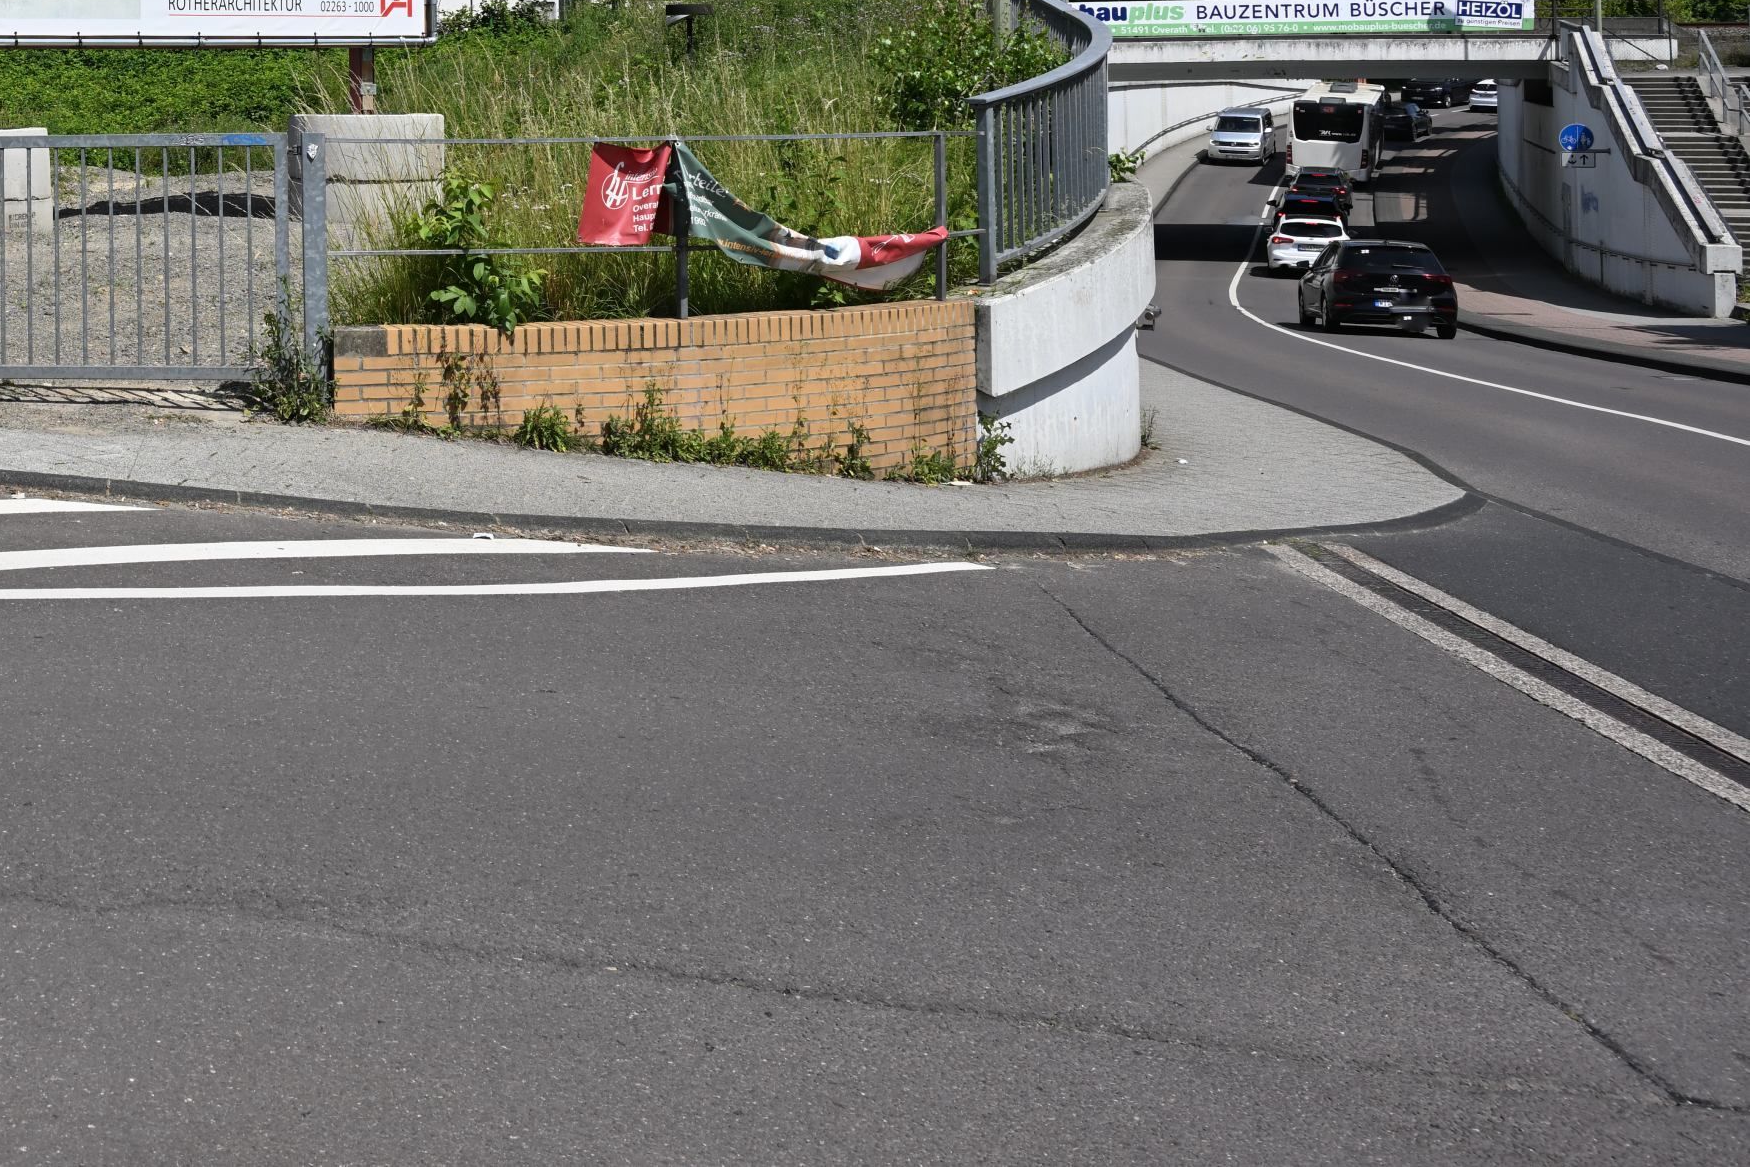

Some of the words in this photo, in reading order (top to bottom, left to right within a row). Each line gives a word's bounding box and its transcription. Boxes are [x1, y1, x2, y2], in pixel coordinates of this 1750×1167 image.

[321, 1, 346, 12] 02263
[354, 1, 374, 12] 1000
[1196, 3, 1339, 19] BAUZENTRUM
[1350, 0, 1445, 17] BÜSCHER
[1458, 0, 1521, 18] HEIZÖL
[1121, 26, 1149, 34] 51491
[1152, 25, 1188, 34] Overath
[1264, 24, 1274, 32] 95
[1277, 24, 1298, 32] 76-0
[1313, 21, 1446, 32] www.mobauplus-buescher.de
[633, 224, 648, 232] Tel.
